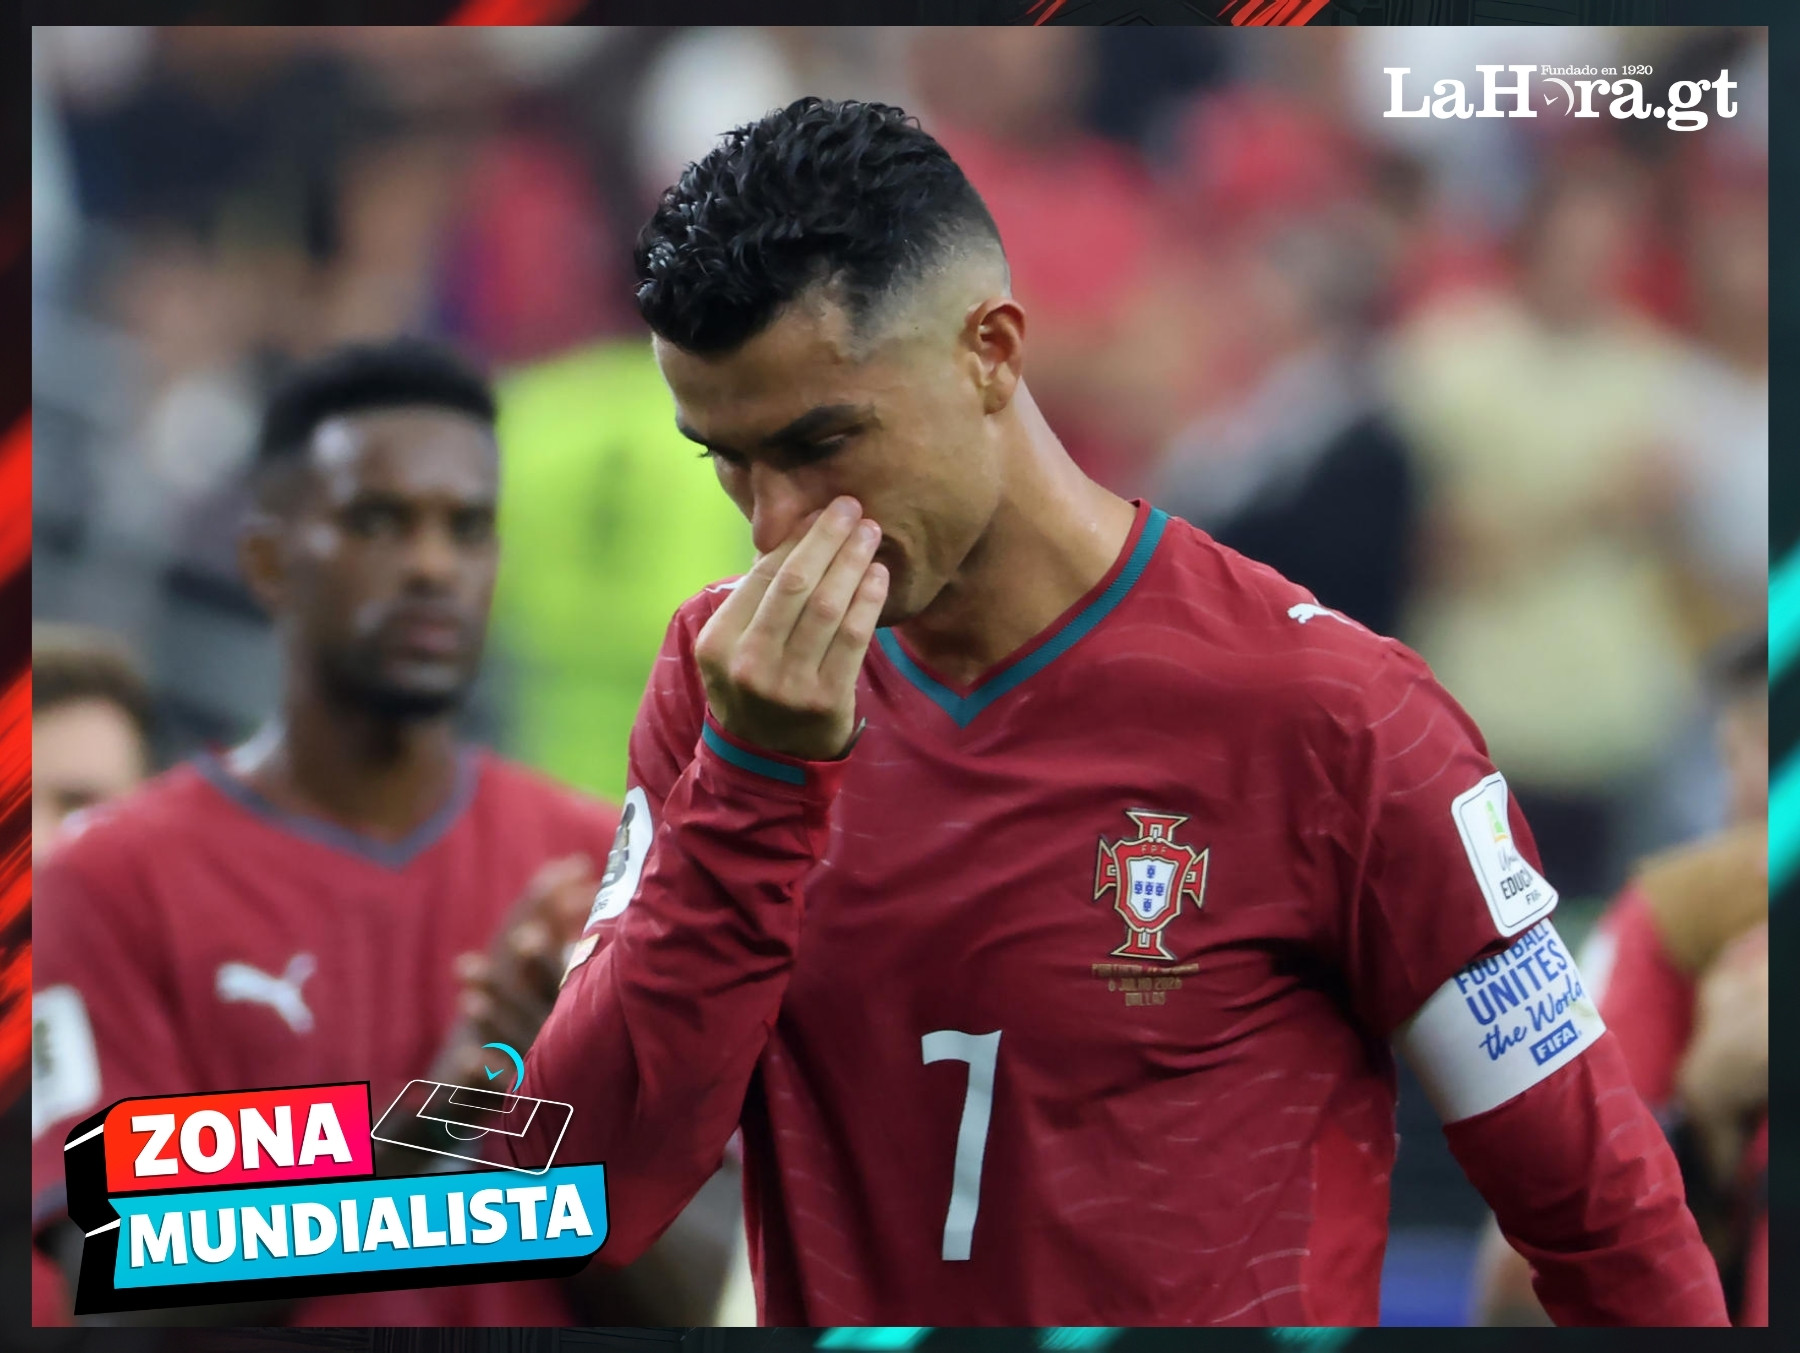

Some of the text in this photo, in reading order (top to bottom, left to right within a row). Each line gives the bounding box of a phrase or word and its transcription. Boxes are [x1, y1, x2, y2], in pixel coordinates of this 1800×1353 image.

[1466, 938, 1567, 1025] UNITES
[1479, 1024, 1527, 1061] the
[1535, 1026, 1576, 1061] FIFA
[921, 1029, 1002, 1261] 7
